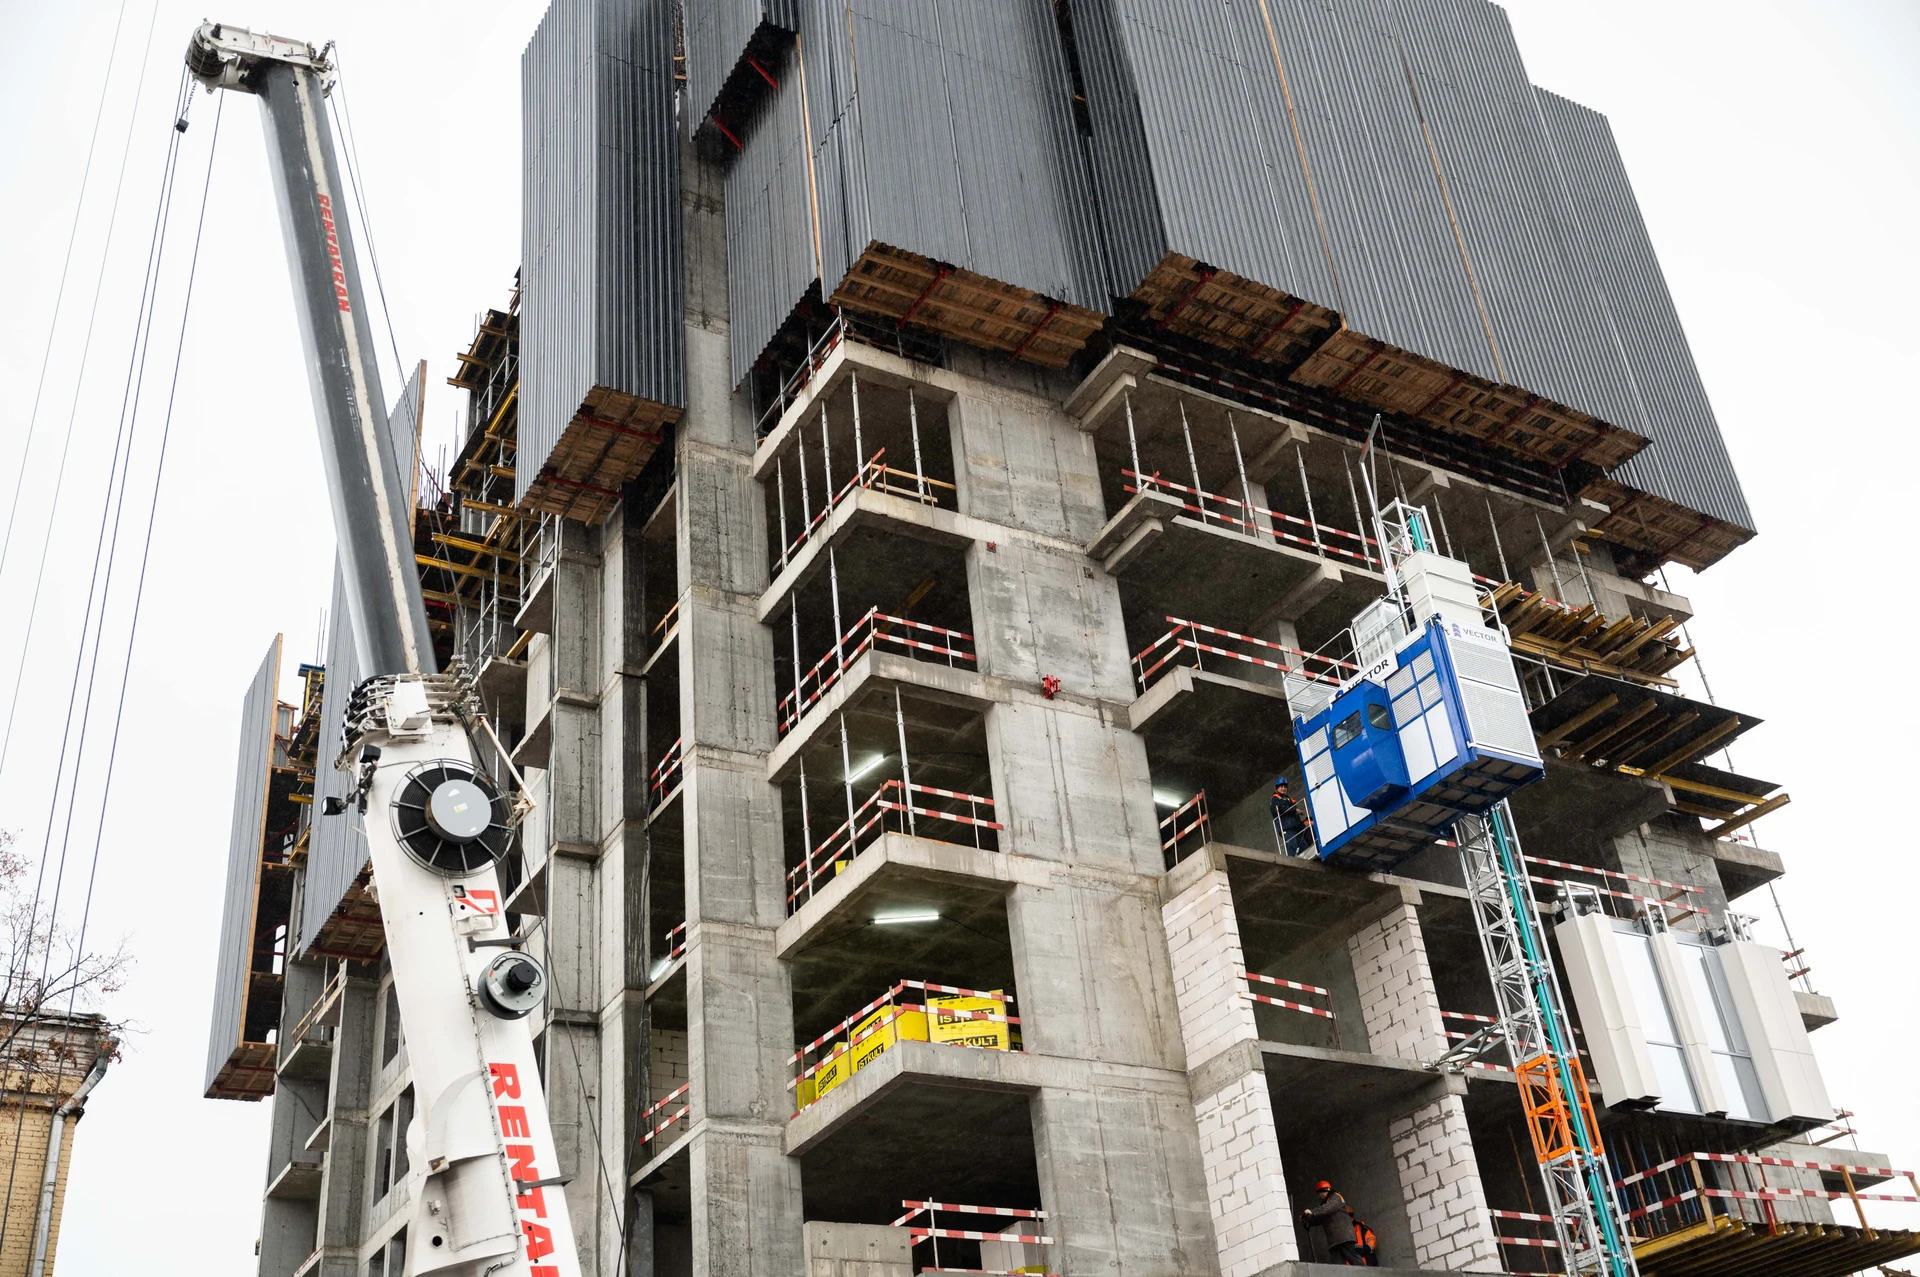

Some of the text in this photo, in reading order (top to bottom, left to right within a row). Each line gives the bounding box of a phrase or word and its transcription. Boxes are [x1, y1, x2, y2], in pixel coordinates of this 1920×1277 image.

[317, 193, 351, 313] RENTAKRAN
[1462, 627, 1498, 643] VECTOR
[1347, 658, 1389, 690] CTOR
